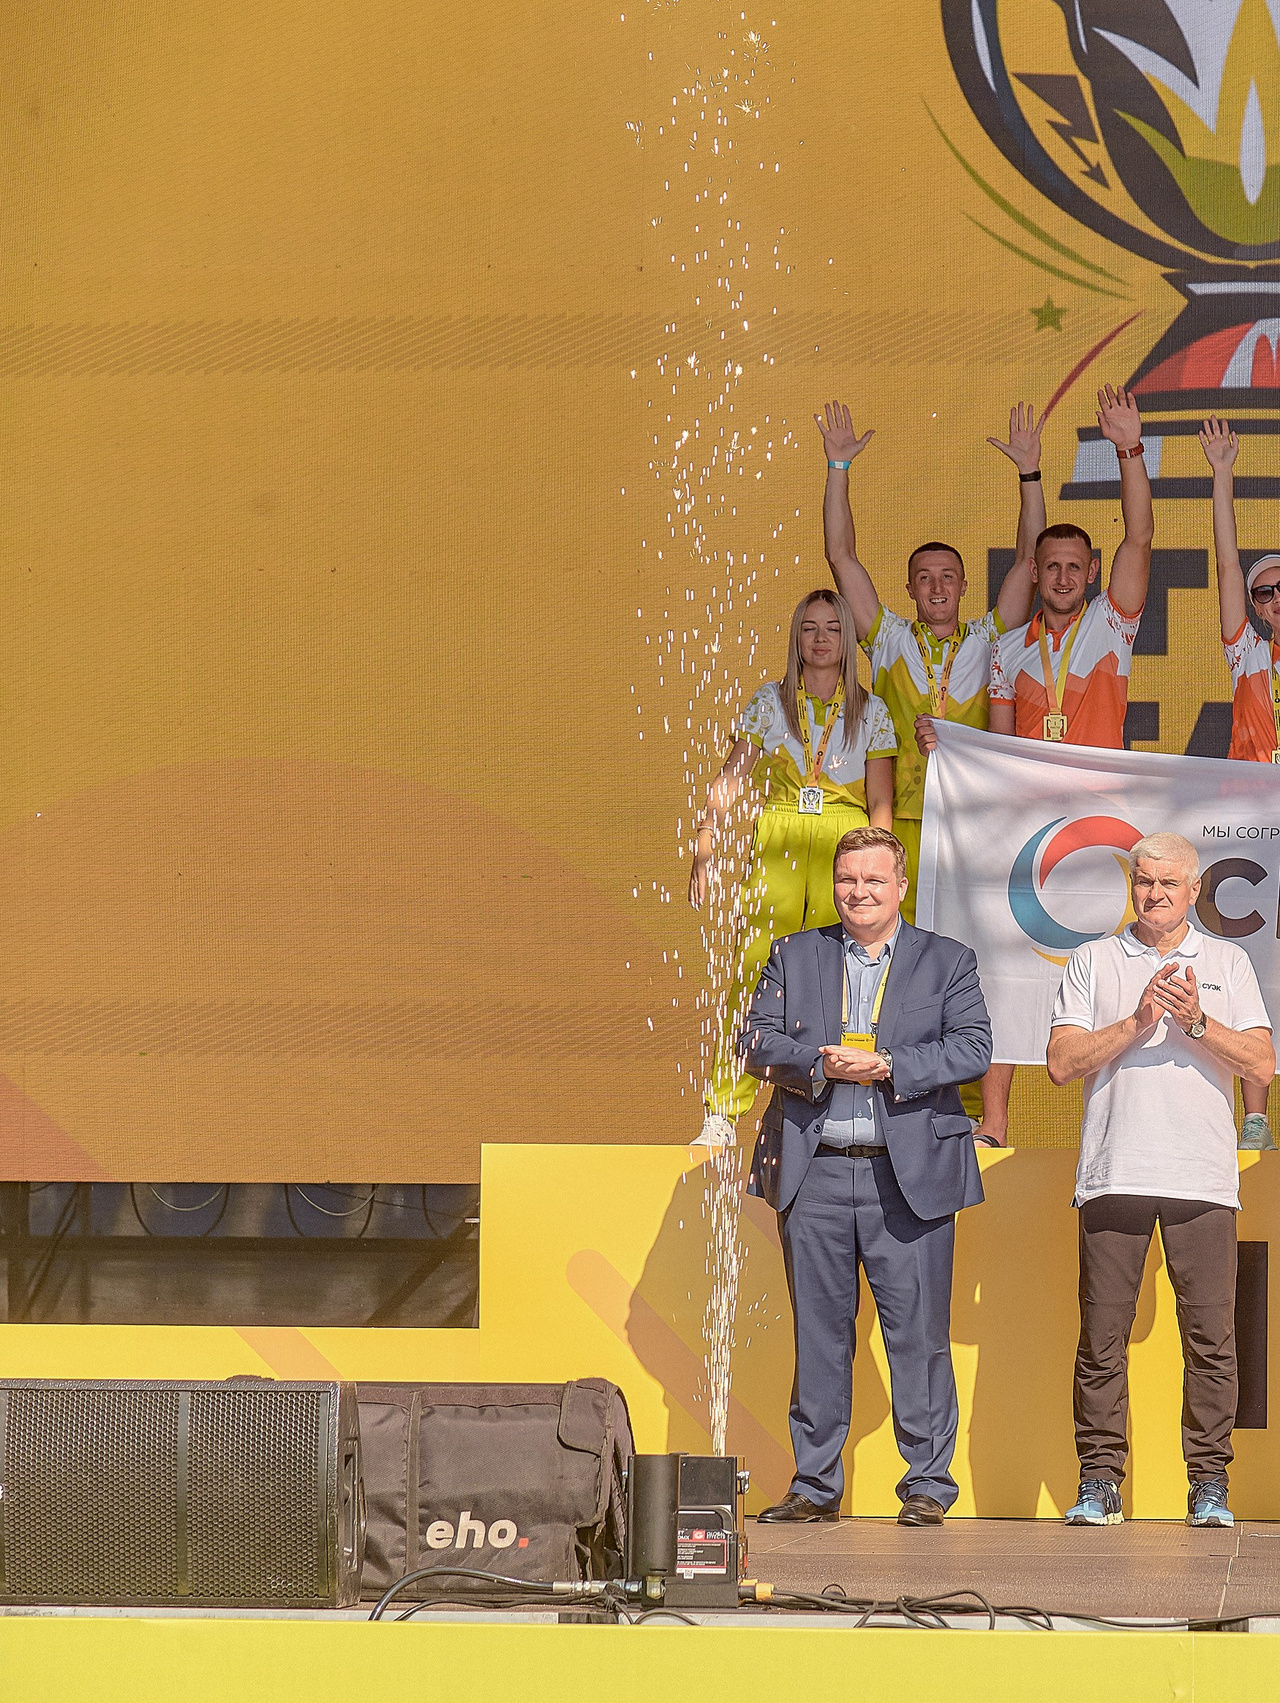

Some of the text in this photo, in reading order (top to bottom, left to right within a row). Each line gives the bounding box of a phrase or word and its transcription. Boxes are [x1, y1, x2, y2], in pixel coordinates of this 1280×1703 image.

[1202, 825, 1230, 838] МЫ
[1202, 982, 1222, 992] СУЭК
[425, 1511, 530, 1549] eho.
